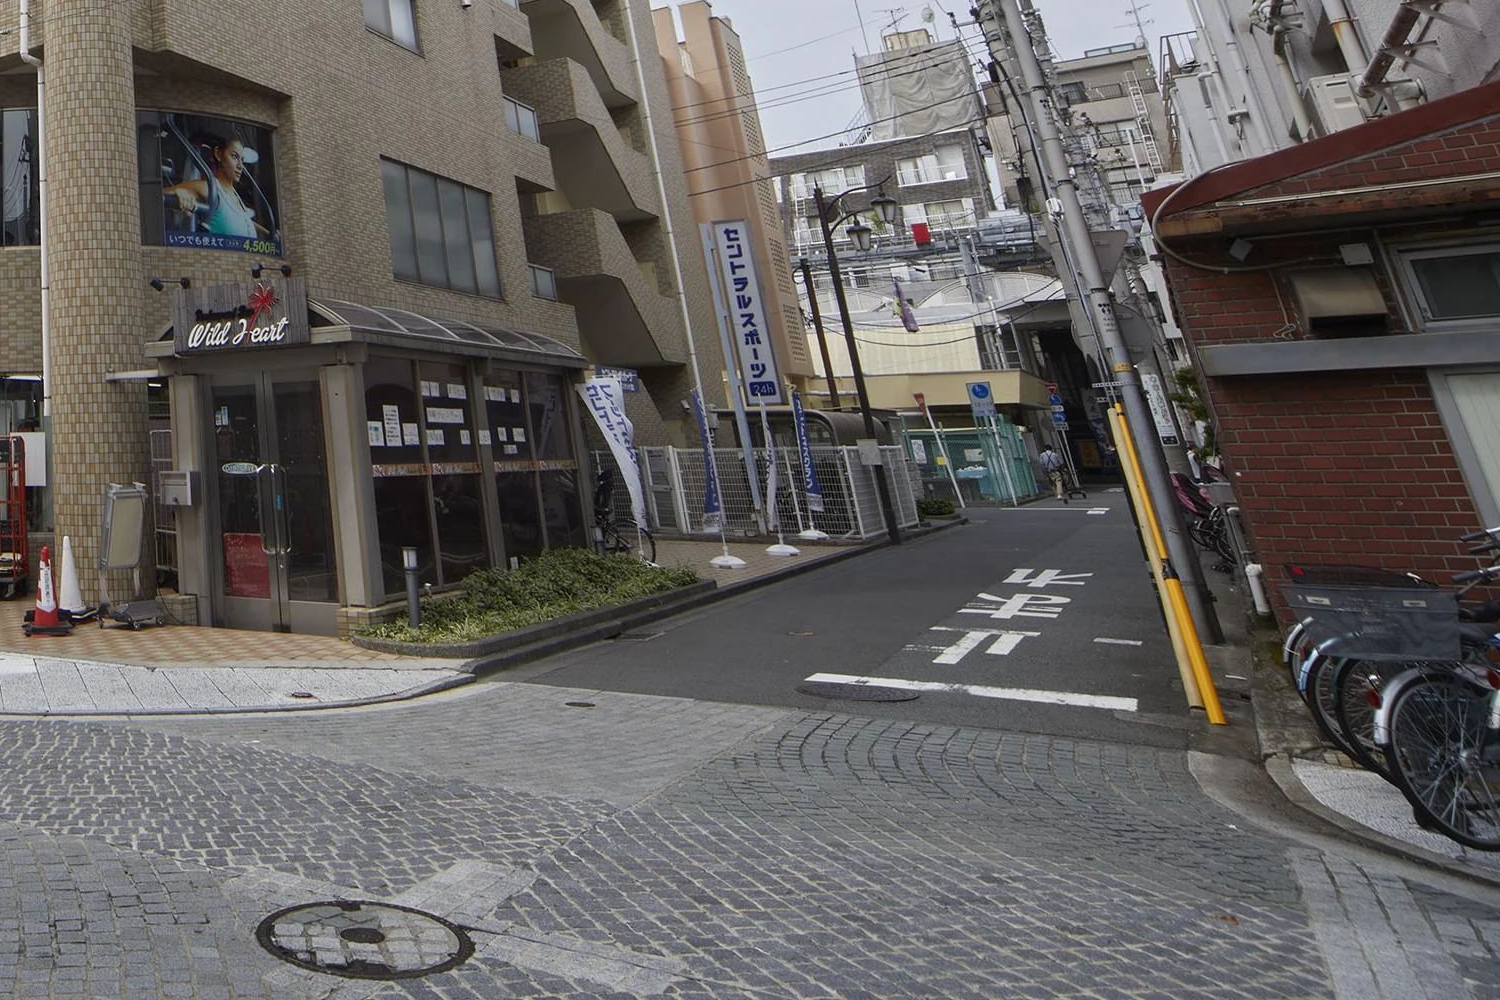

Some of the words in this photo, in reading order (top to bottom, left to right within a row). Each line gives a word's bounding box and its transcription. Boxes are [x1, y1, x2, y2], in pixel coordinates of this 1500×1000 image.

[169, 235, 224, 247] いつでも使えて
[723, 227, 767, 379] セントラルスポーツ
[188, 321, 231, 348] Wild
[754, 384, 775, 394] 24h
